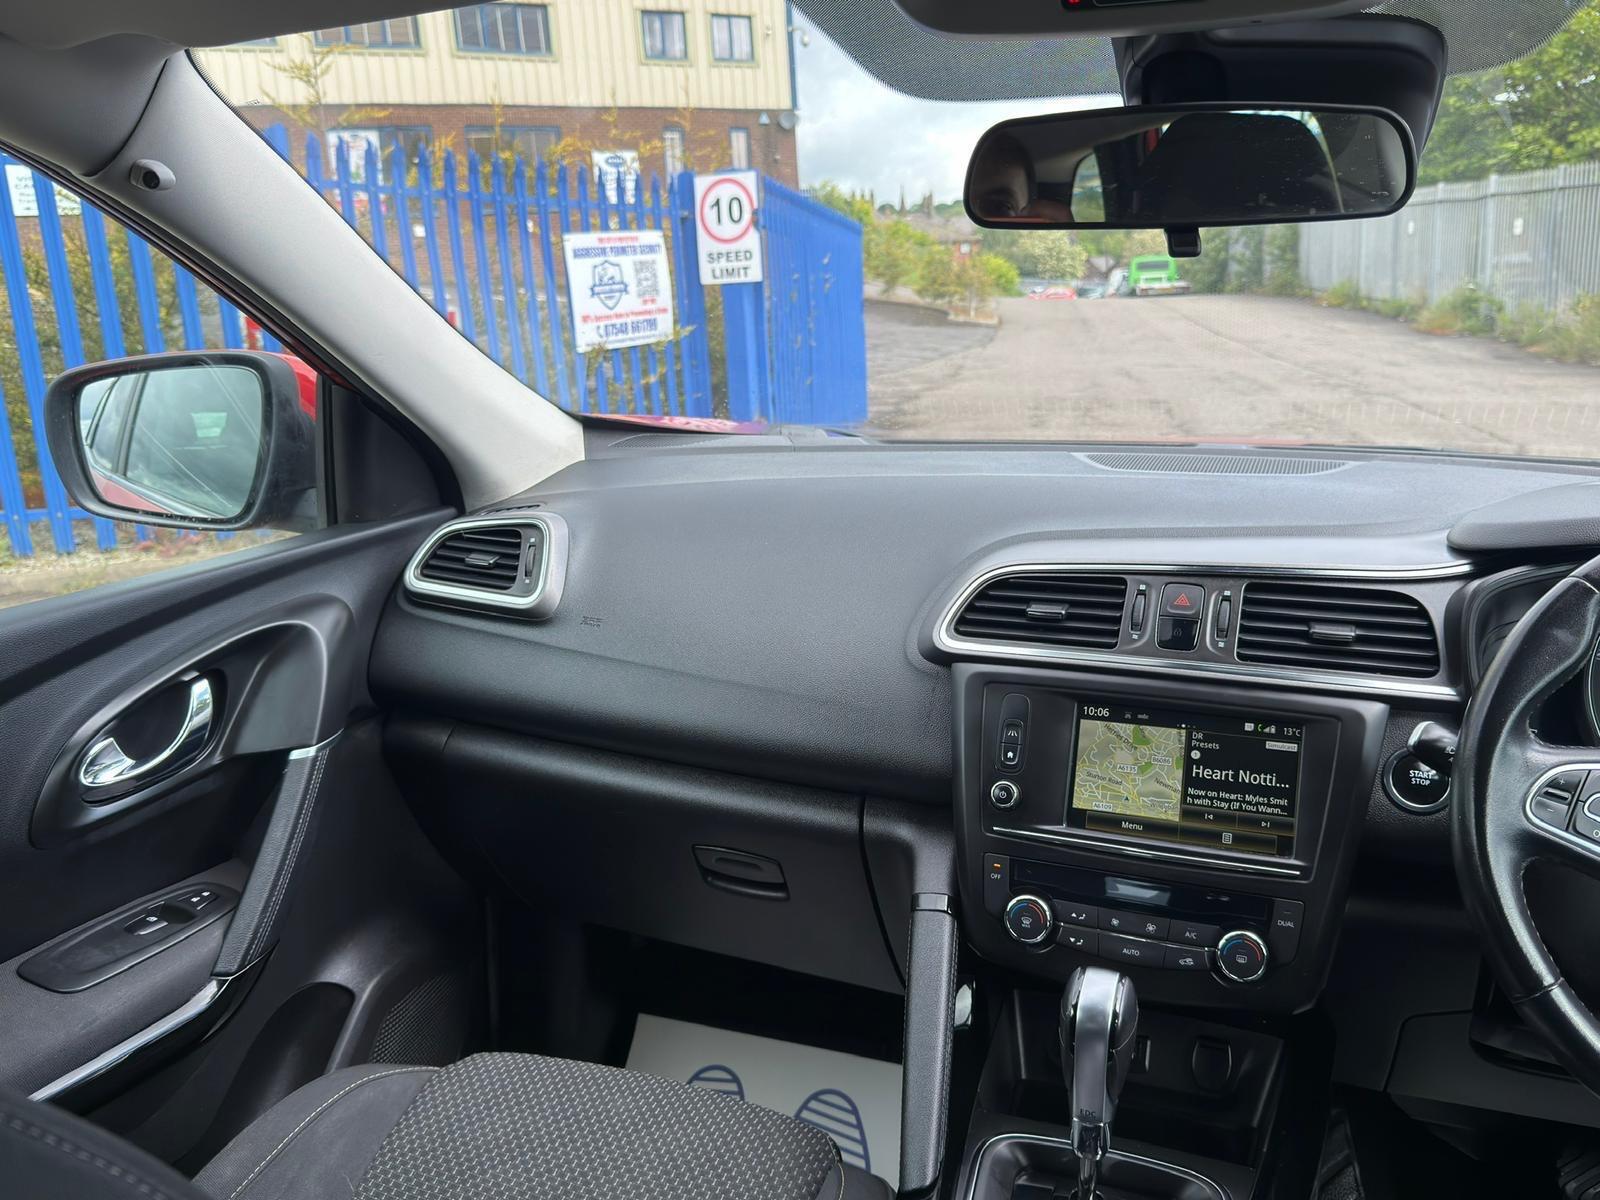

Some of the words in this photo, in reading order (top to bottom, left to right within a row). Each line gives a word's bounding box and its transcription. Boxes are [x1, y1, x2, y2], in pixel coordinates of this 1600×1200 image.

[710, 196, 743, 225] 10
[706, 250, 753, 264] SPEED
[711, 266, 751, 280] LIMIT
[1083, 706, 1110, 717] 10:06
[1192, 731, 1204, 740] DR
[1283, 727, 1301, 737] 13°C
[1191, 740, 1220, 750] Presets
[1192, 764, 1234, 782] Heart
[1239, 770, 1290, 788] Notti...
[1409, 770, 1432, 779] START
[1411, 778, 1431, 786] STOP
[1187, 787, 1206, 796] Now
[1219, 791, 1244, 801] Heart:
[1245, 794, 1268, 804] Myles
[1270, 796, 1288, 806] Smit
[1093, 802, 1113, 811] A6109
[1186, 796, 1193, 804] h
[1193, 797, 1211, 806] with
[1213, 799, 1229, 809] Stay
[1230, 801, 1240, 810] (If
[1241, 802, 1257, 812] You
[1258, 804, 1288, 815] Wann...
[1121, 821, 1143, 831] Menu
[1277, 919, 1296, 928] DUAL
[1184, 930, 1199, 940] A/C
[1122, 948, 1140, 957] AUTO
